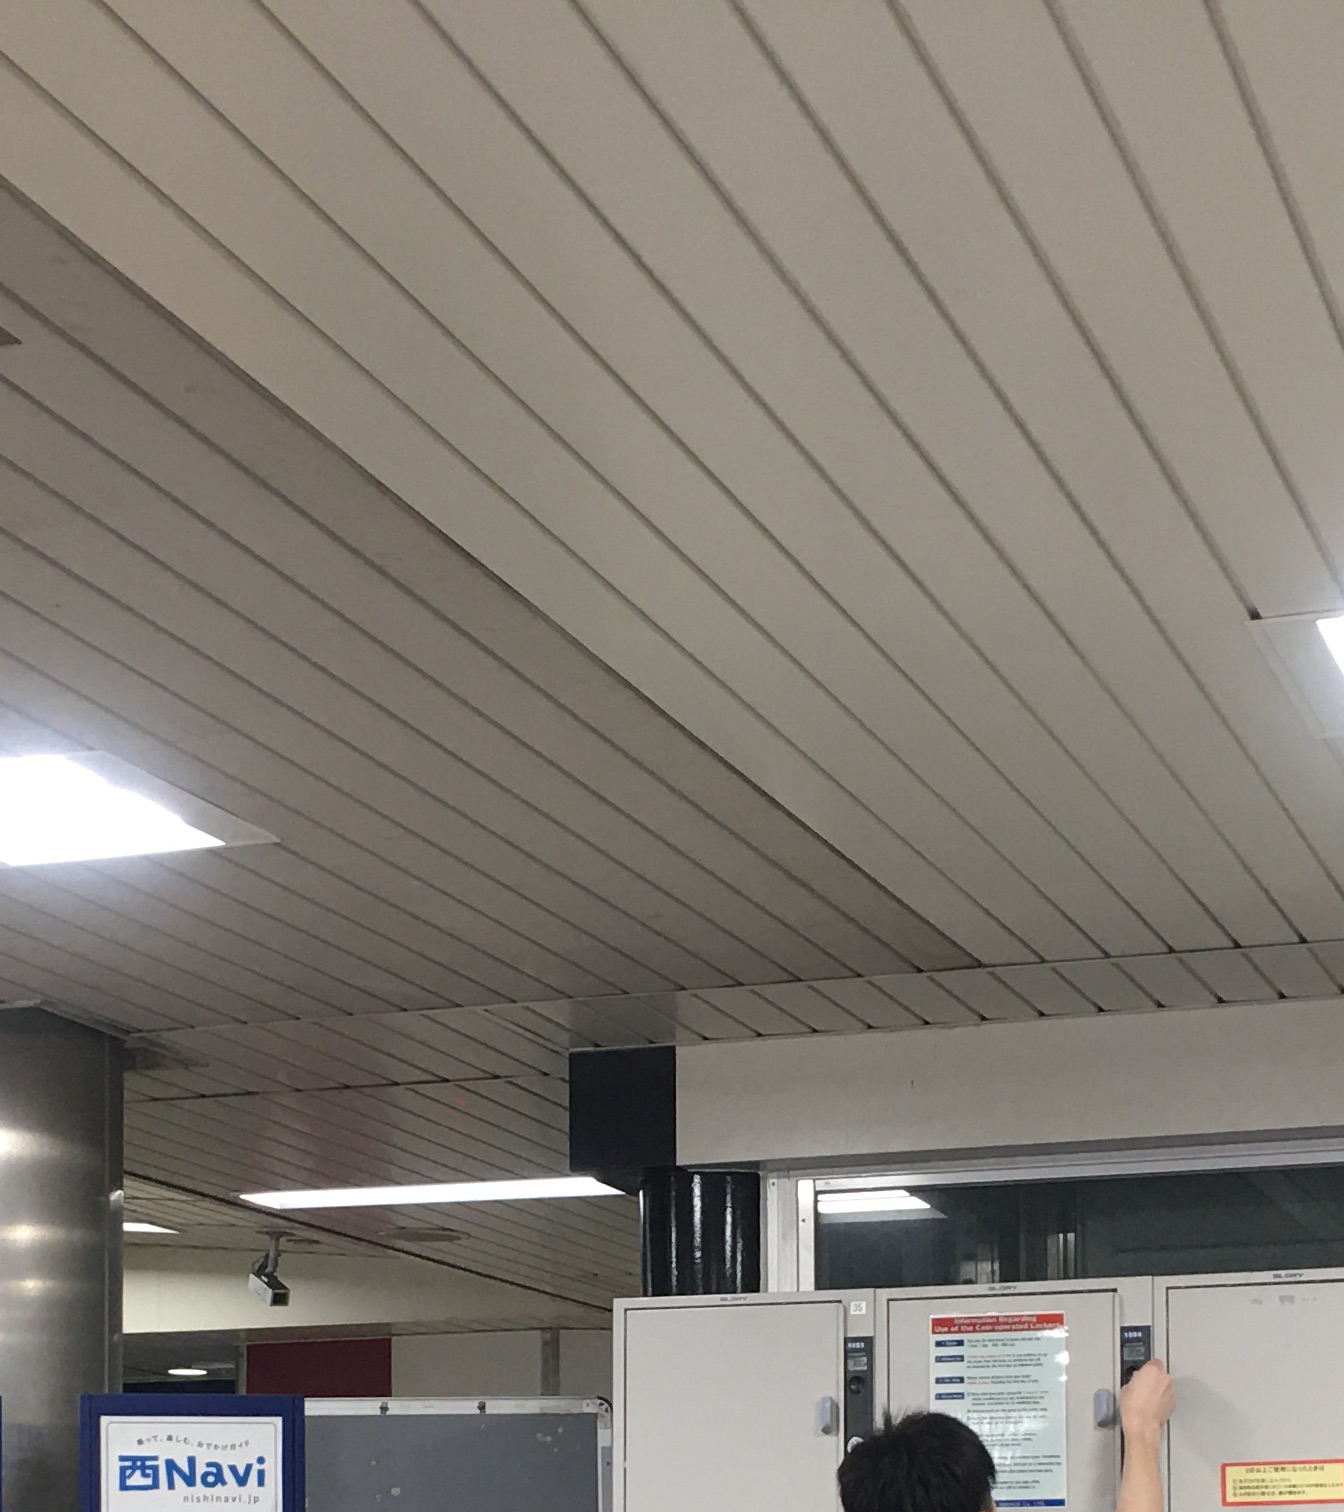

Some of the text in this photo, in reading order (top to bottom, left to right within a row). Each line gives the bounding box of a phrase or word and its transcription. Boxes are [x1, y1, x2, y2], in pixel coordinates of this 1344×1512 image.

[852, 1303, 863, 1312] 35
[954, 1316, 1037, 1324] Information Regarding
[975, 1323, 1028, 1332] Coin-operated
[118, 1455, 266, 1492] 西Navi
[183, 1493, 260, 1505] nishinavi.jp
